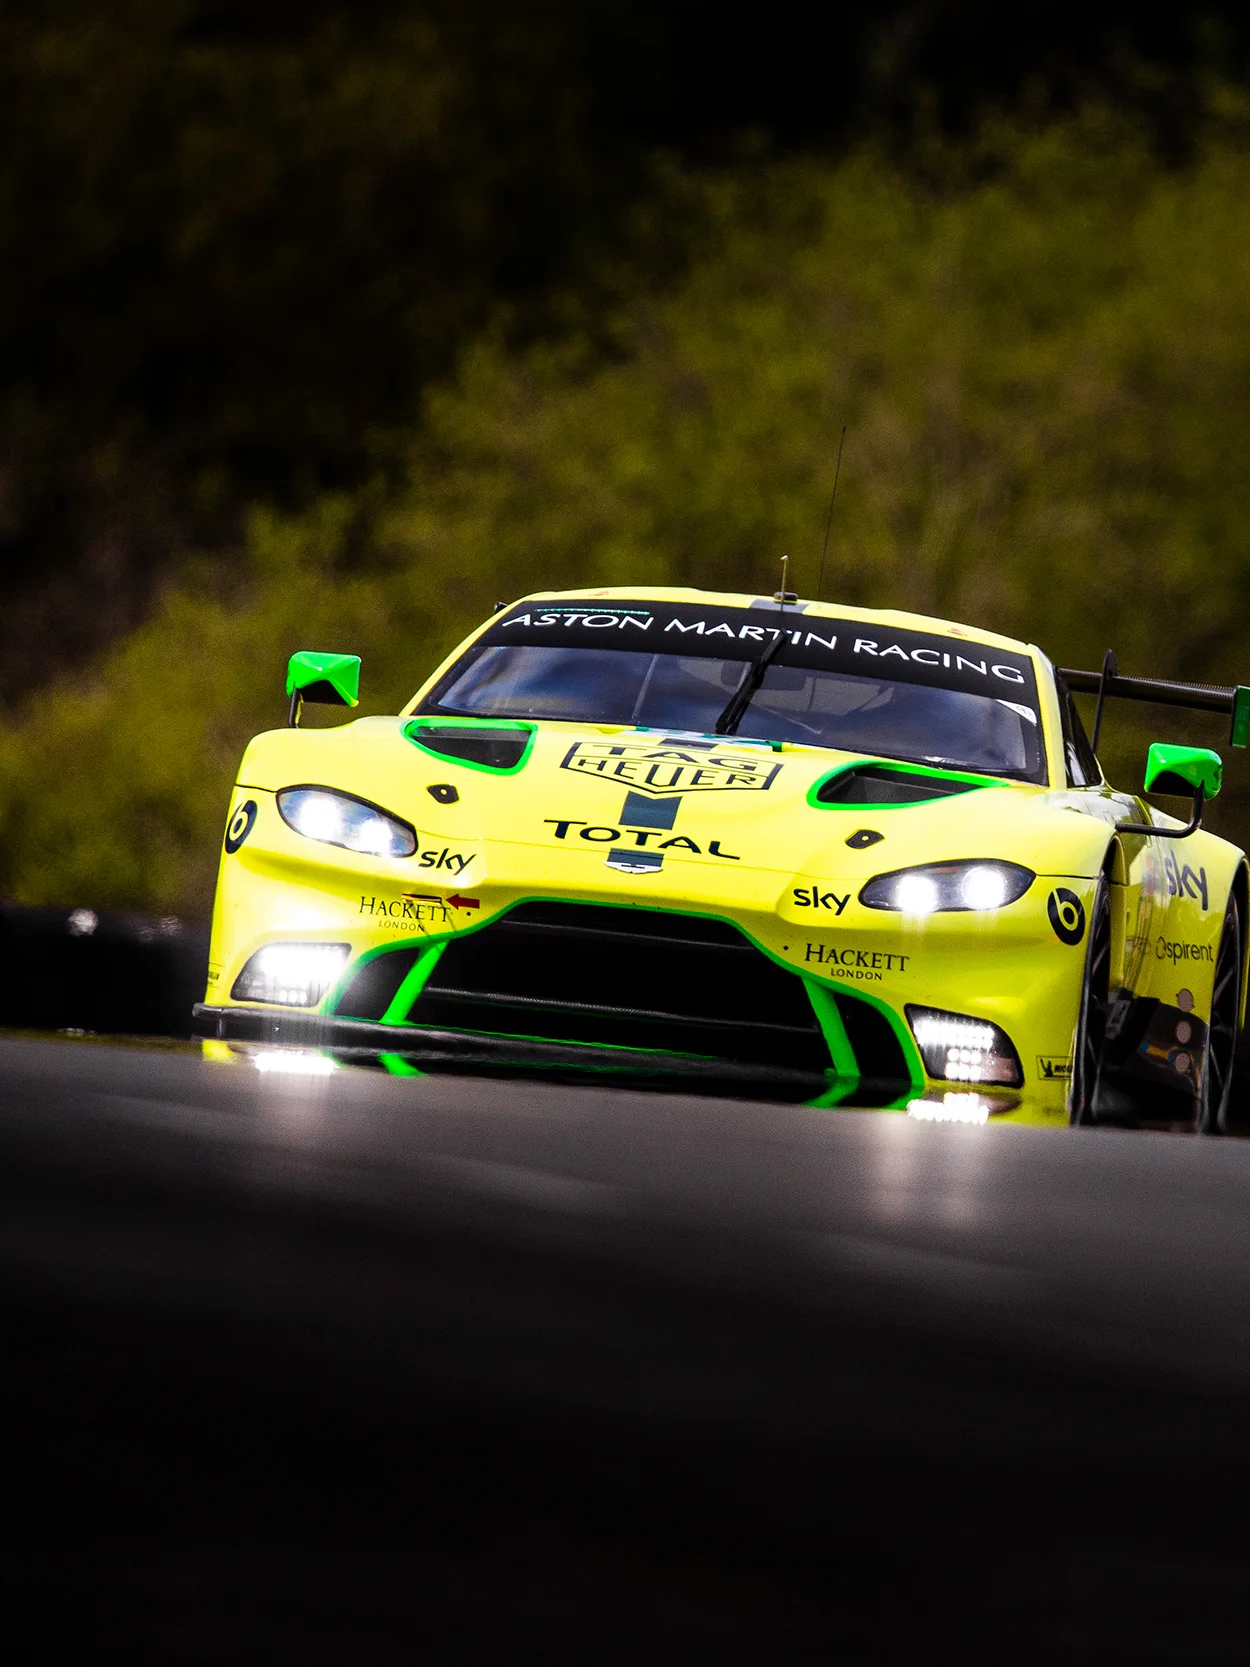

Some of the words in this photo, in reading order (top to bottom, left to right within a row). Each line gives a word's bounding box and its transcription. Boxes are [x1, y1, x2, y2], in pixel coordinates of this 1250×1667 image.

[502, 612, 654, 631] ASTON
[664, 617, 838, 650] MARTIN
[853, 637, 1025, 684] RACING
[592, 744, 759, 771] TAG
[577, 758, 757, 788] HEUER
[543, 818, 741, 860] TOTAL
[418, 848, 477, 876] sky
[1164, 849, 1208, 911] sky
[359, 896, 451, 923] HACKETT
[792, 886, 851, 916] sky
[378, 919, 425, 932] LONDON
[804, 943, 910, 972] HACKETT
[830, 967, 883, 981] LONDON
